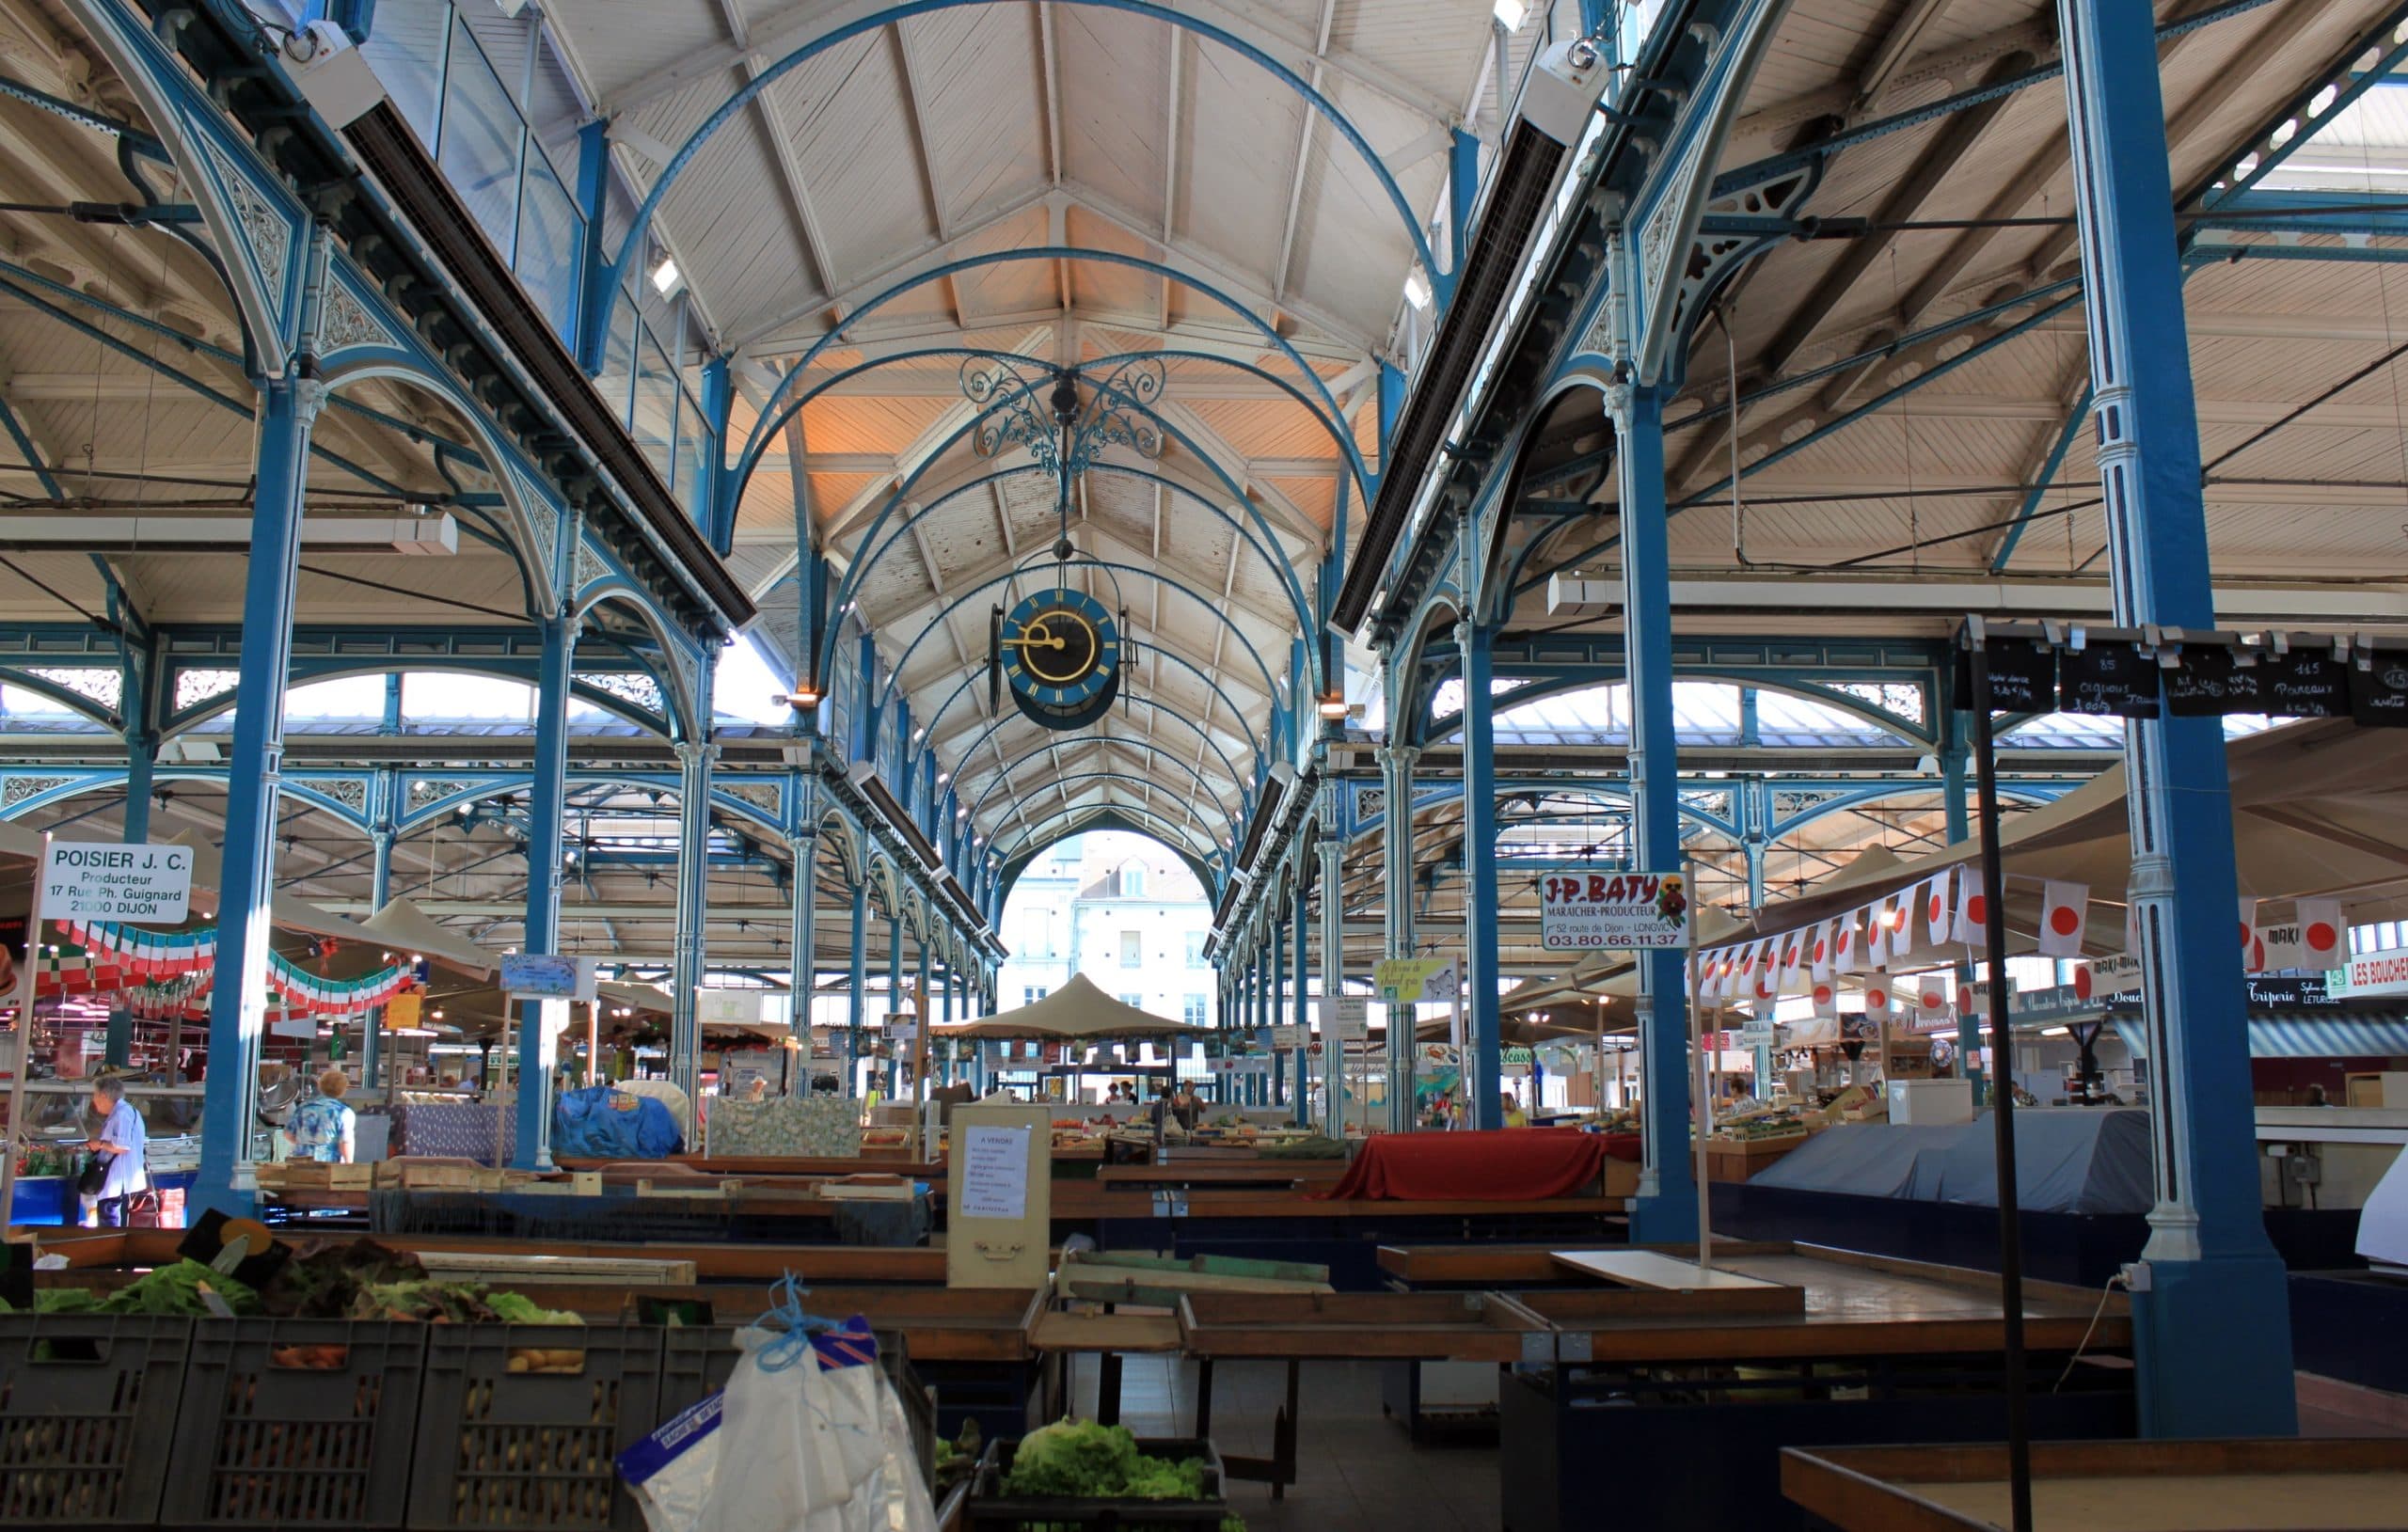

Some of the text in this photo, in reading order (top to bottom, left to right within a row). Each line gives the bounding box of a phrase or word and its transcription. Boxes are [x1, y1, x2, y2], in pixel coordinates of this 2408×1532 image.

[55, 849, 186, 870] POISIER J. C.
[81, 872, 152, 885] Producteur
[50, 885, 182, 902] 17 Rue Ph. Guignard
[71, 900, 157, 914] 21000 DIJON
[1569, 924, 1589, 933] route
[1592, 924, 1602, 932] de
[1605, 923, 1624, 933] Dijon
[1634, 923, 1670, 933] LONGVIC
[1548, 935, 1678, 946] 03.80.66.11.37
[2352, 957, 2408, 986] LES BOUCHE
